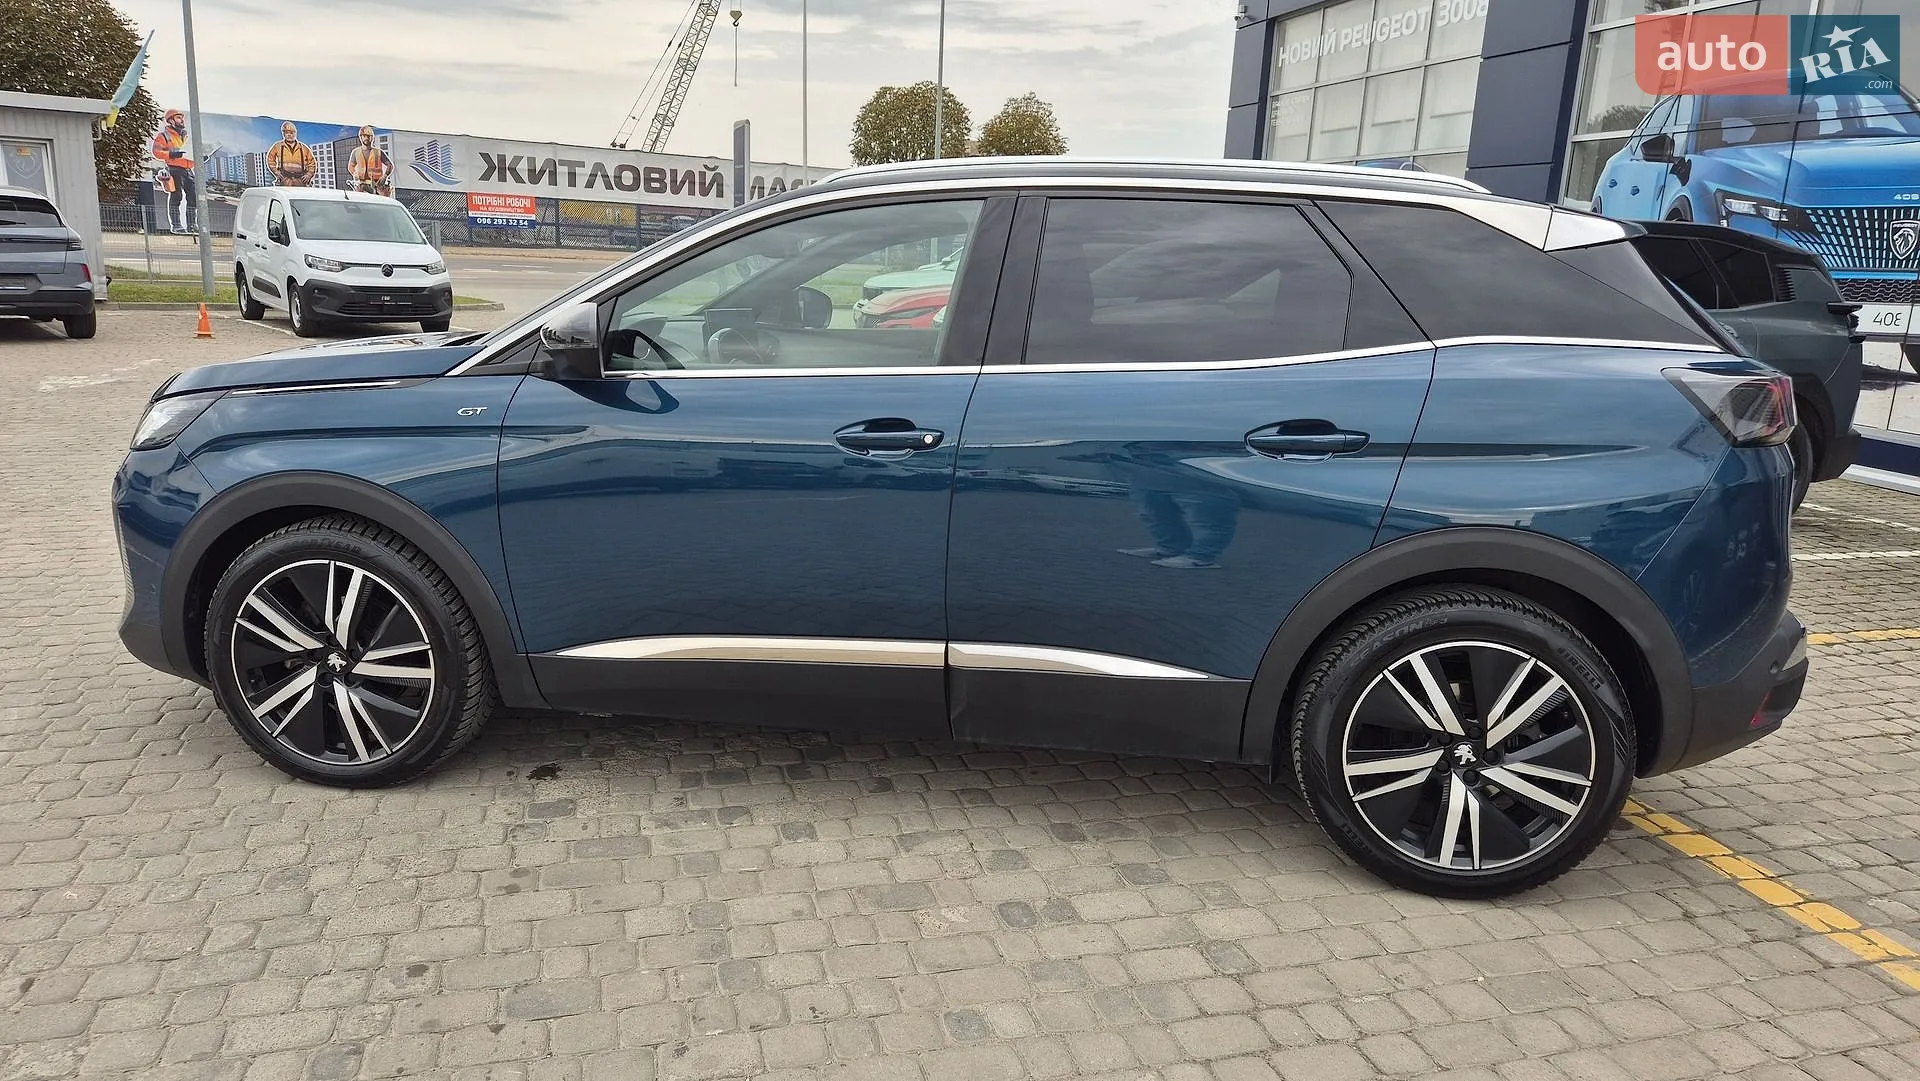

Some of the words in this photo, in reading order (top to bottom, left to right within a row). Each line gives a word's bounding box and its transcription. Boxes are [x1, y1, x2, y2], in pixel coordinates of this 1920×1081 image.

[1279, 28, 1336, 67] НОВИЙ
[1340, 6, 1431, 51] PEUGEOT
[478, 152, 724, 198] ЖИТЛОВИЙ
[472, 195, 505, 206] ПОТРІБНІ
[505, 197, 531, 208] РОБОЧІ
[457, 406, 488, 416] GT
